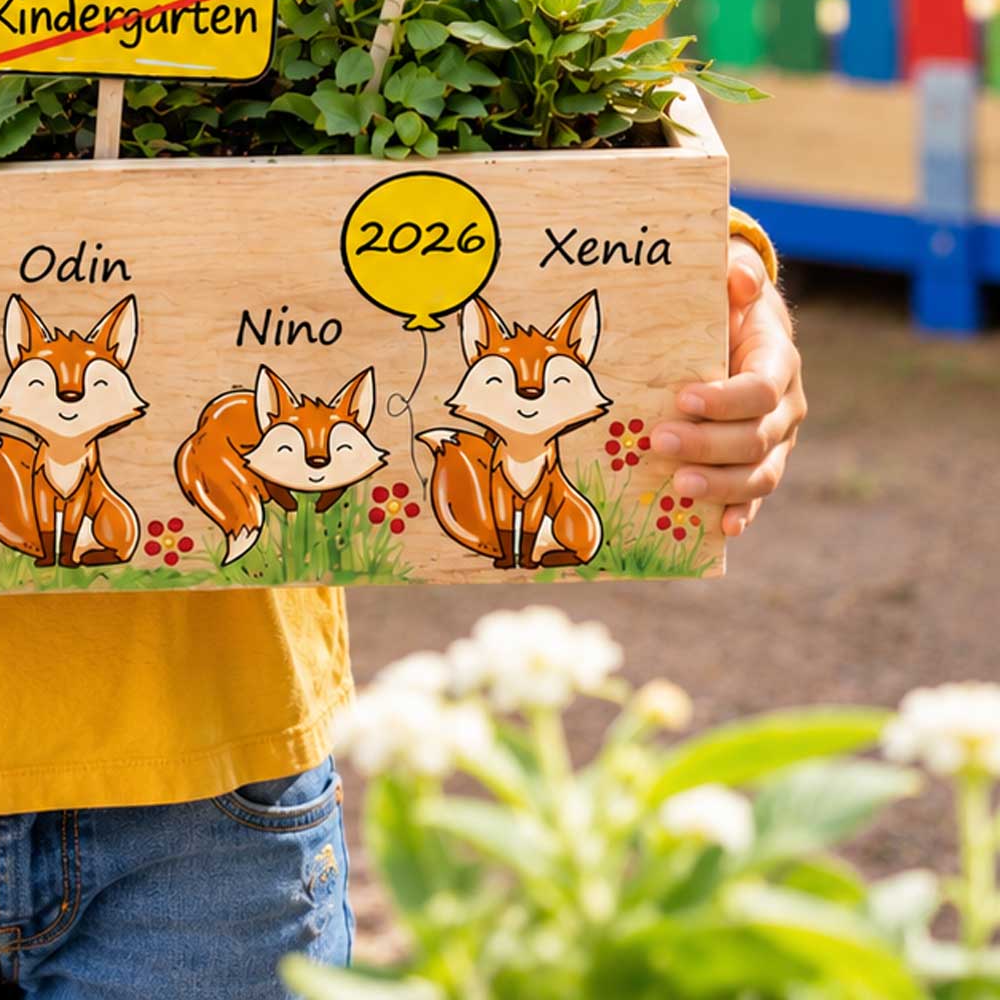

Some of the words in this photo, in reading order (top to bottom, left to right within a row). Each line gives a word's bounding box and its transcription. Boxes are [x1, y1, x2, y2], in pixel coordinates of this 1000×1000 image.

[356, 222, 487, 257] 2026
[540, 227, 672, 269] Xenia
[20, 241, 132, 285] Odin
[237, 306, 343, 348] Nino
